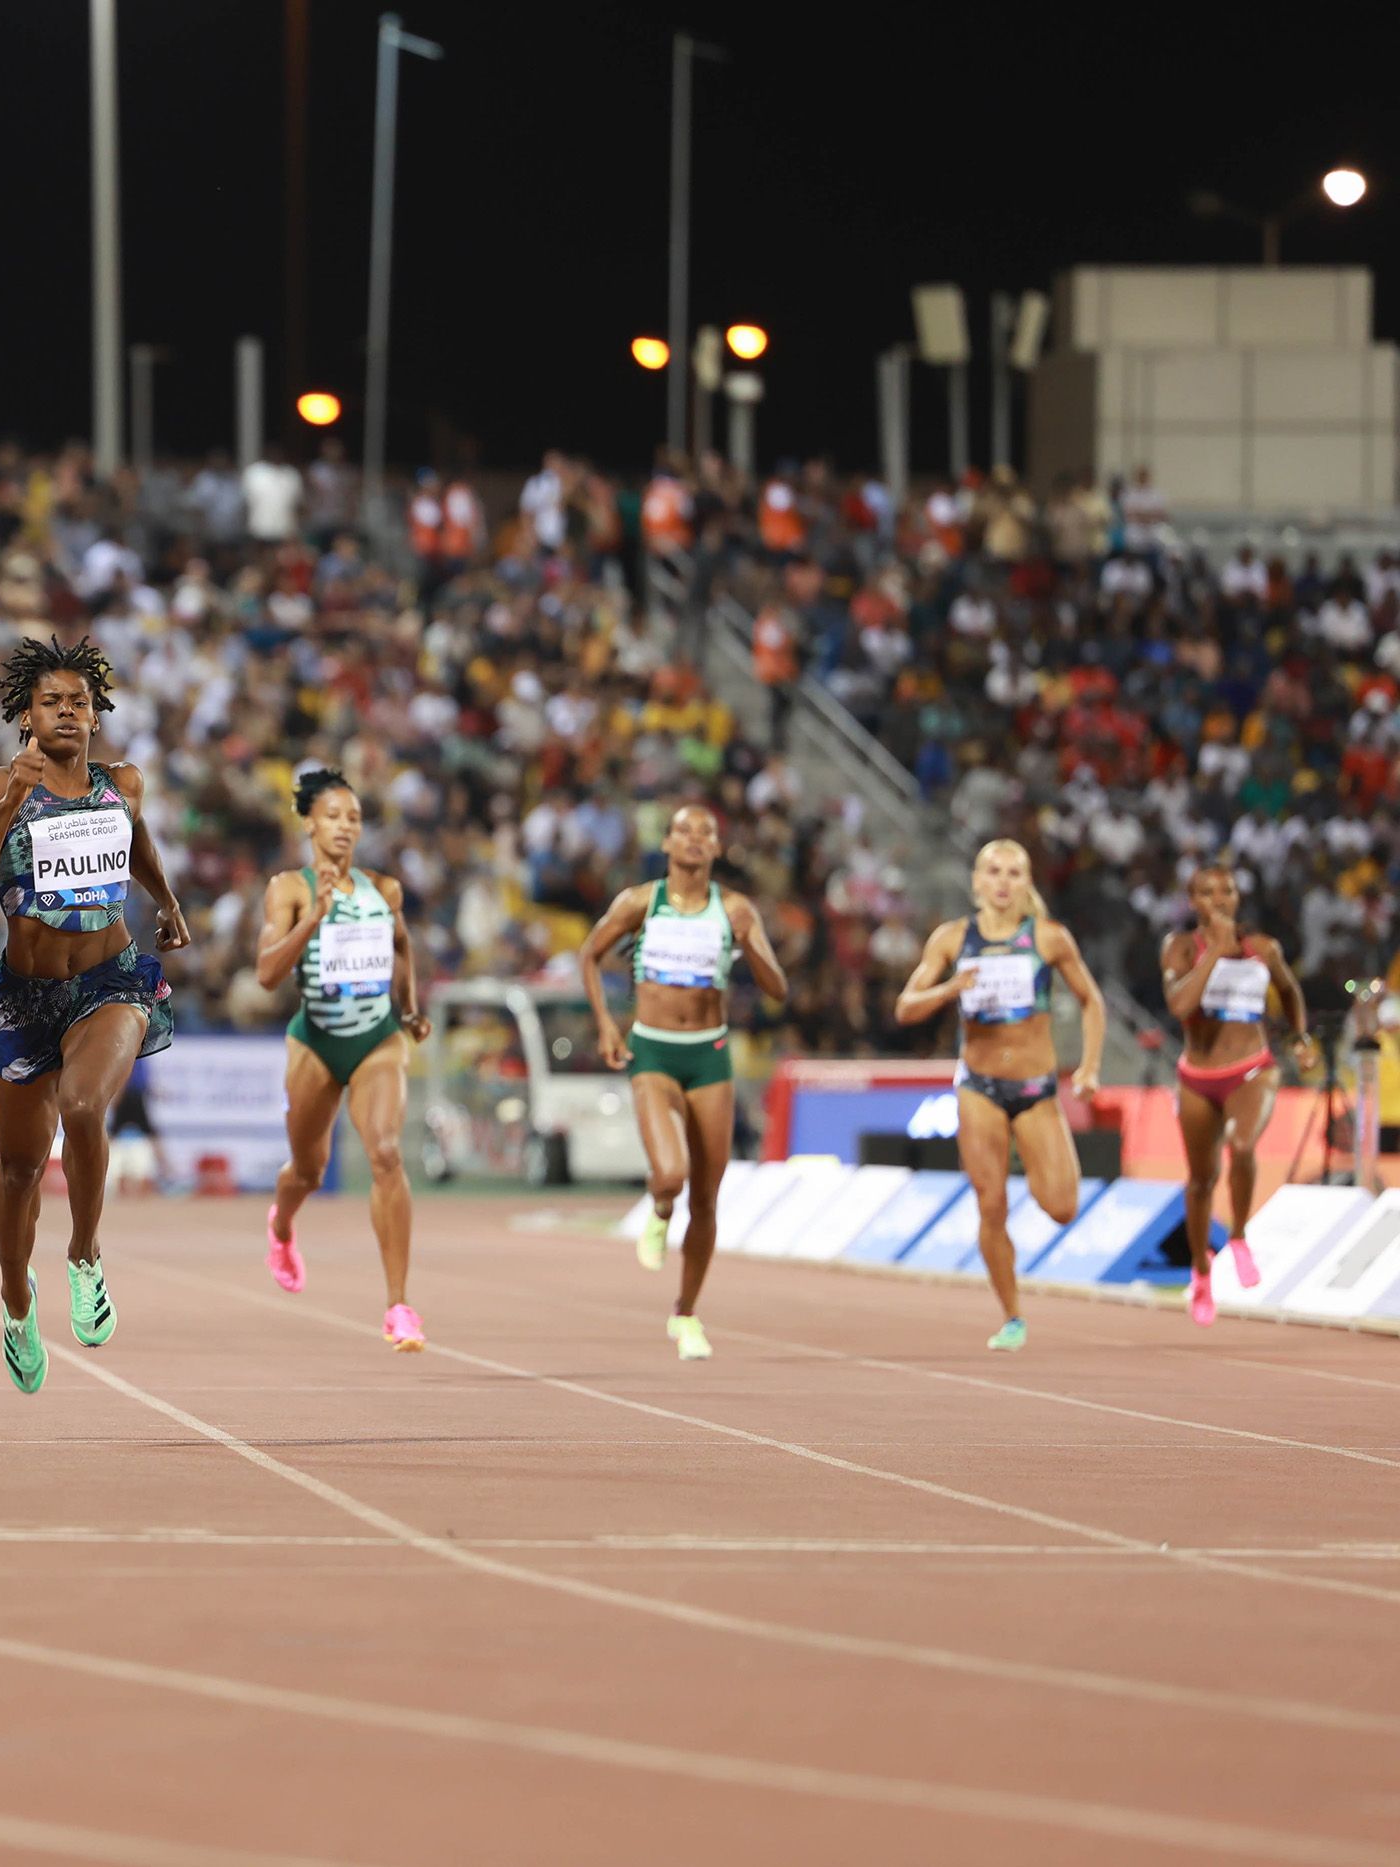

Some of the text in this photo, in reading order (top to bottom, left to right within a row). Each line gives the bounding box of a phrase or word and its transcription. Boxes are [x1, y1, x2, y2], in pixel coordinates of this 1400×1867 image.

[49, 825, 118, 841] SEASHORE GROUP
[38, 850, 126, 878] PAULINO
[75, 890, 108, 903] DOHA
